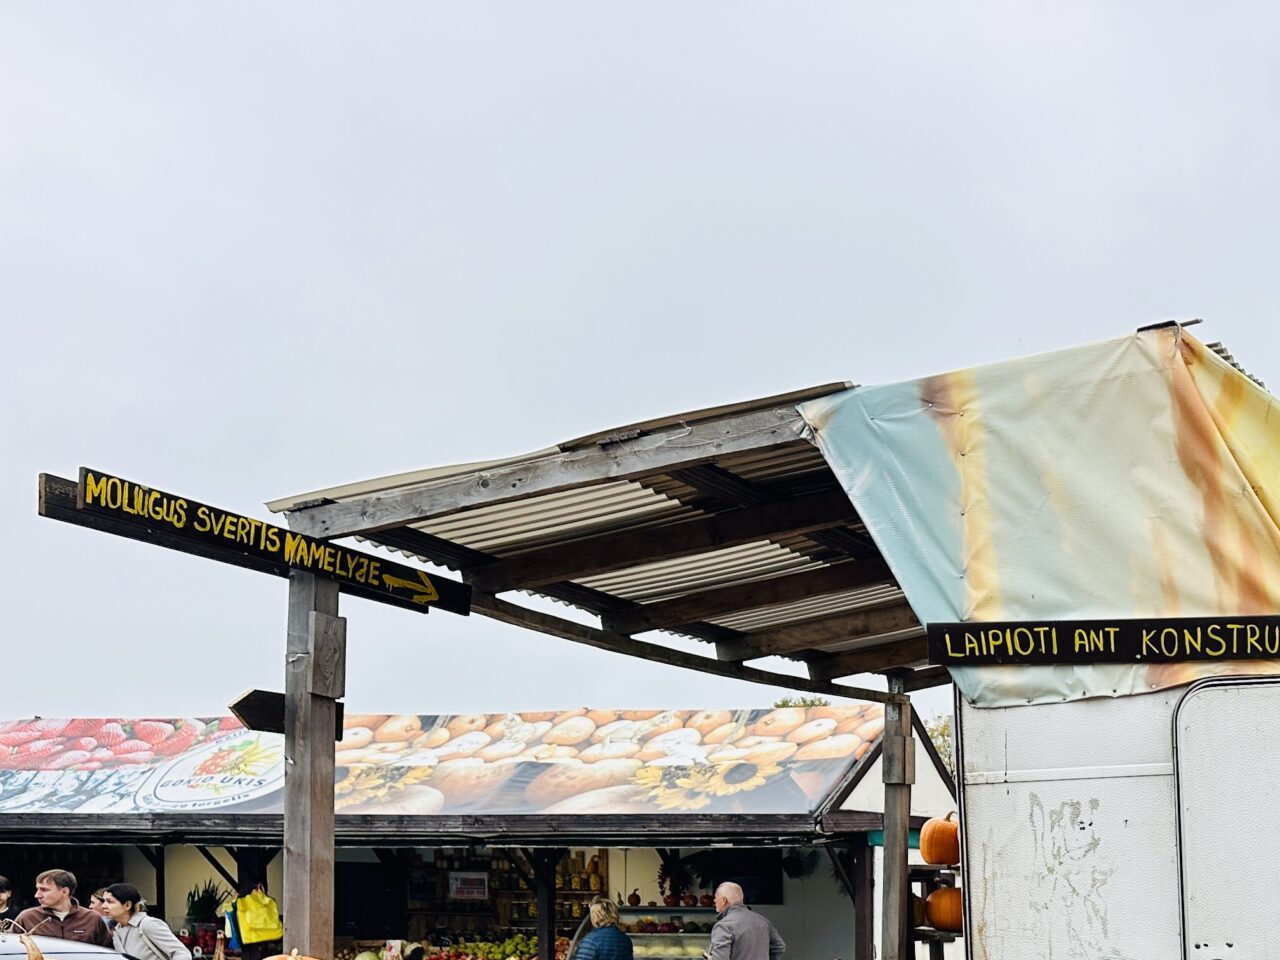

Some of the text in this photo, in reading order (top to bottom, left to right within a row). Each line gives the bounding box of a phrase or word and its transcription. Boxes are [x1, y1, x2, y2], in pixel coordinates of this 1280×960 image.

[194, 507, 281, 553] SVERTIS
[284, 532, 381, 587] NAMELYJE
[945, 627, 1058, 657] LAIPIOTI
[1074, 627, 1120, 653] ANT
